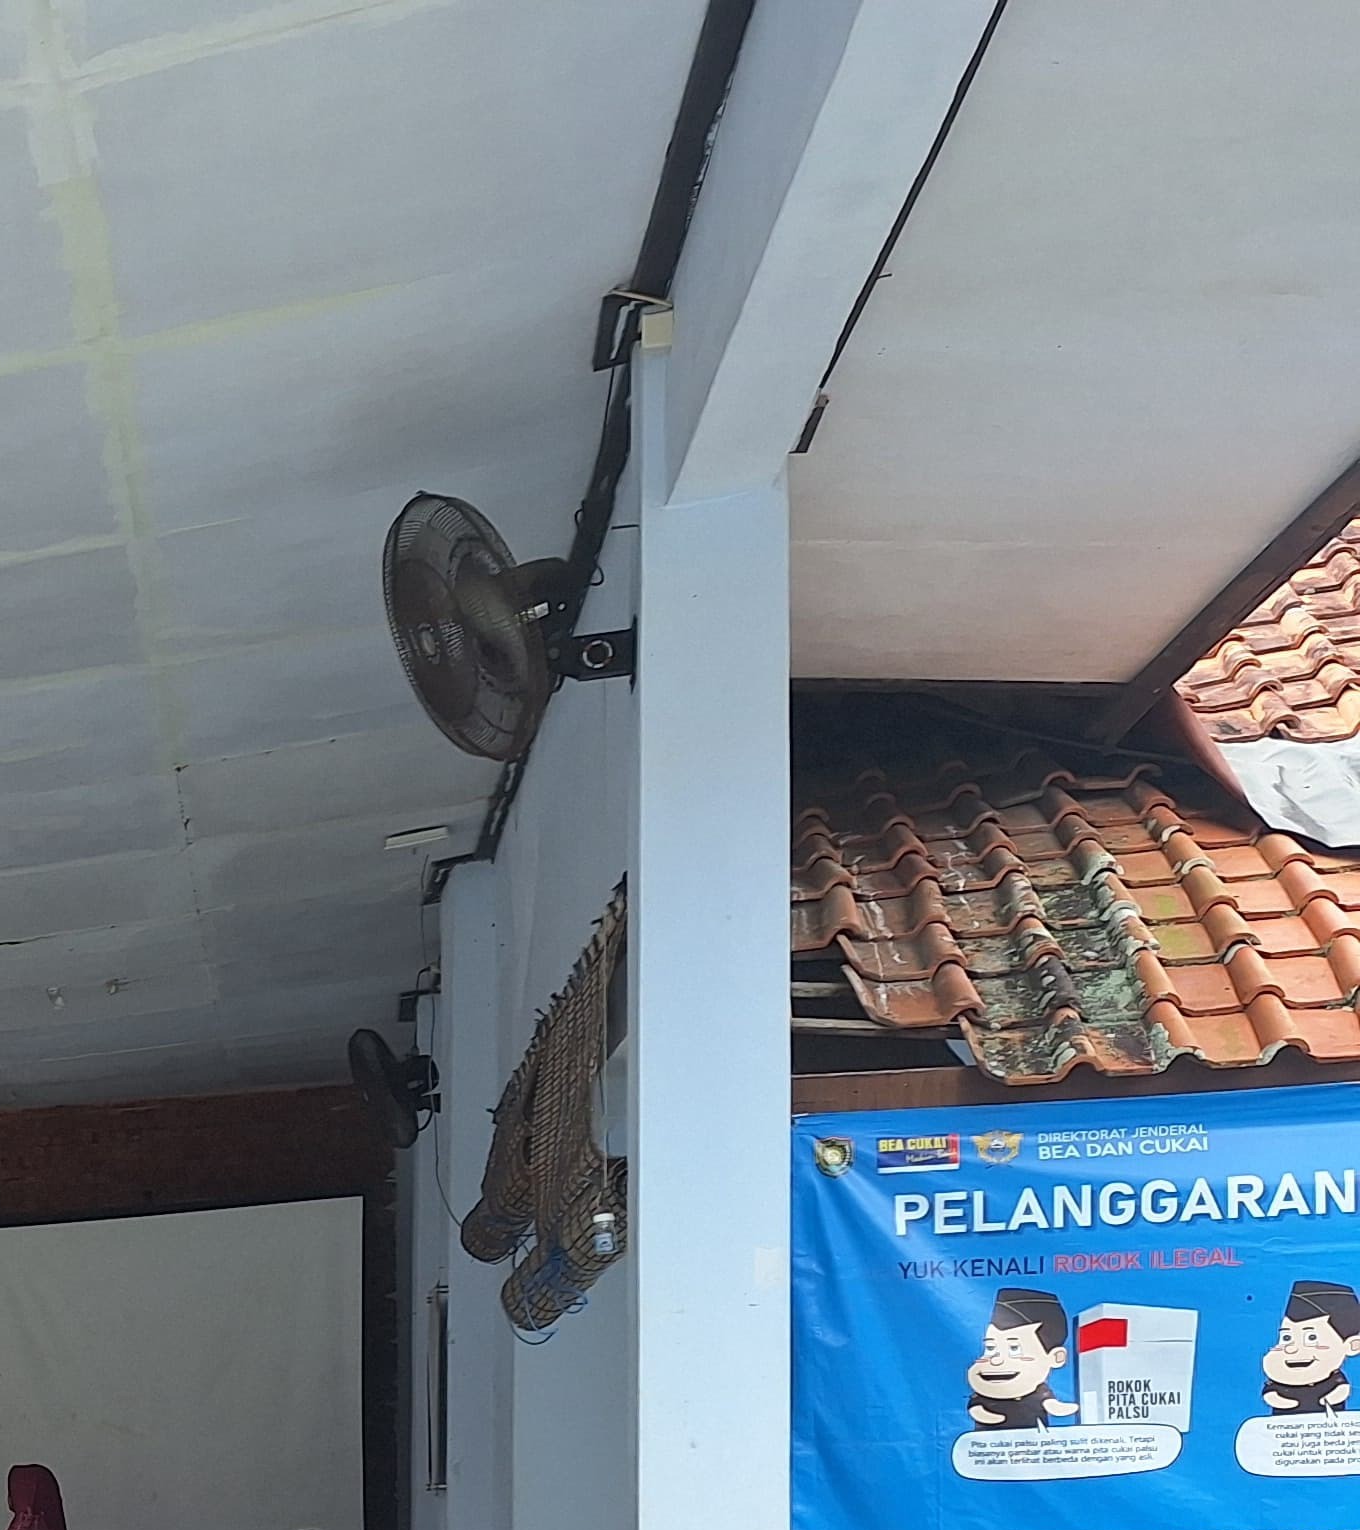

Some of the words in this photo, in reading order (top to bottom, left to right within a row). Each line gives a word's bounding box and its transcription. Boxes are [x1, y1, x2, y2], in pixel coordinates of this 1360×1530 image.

[1038, 1128, 1127, 1144] DIREKTORAT
[1131, 1124, 1208, 1138] JENDERAL
[879, 1139, 904, 1152] BEA
[906, 1137, 947, 1150] CUKAI
[1038, 1145, 1080, 1160] BEA
[1086, 1141, 1133, 1157] DAN
[1139, 1137, 1209, 1154] CUKAI
[894, 1169, 1356, 1236] PELANGGARAN
[898, 1260, 950, 1280] YUK
[953, 1255, 1045, 1277] KENALI
[1053, 1252, 1141, 1274] ROKOK
[1149, 1247, 1244, 1270] ILEGAL
[1108, 1379, 1151, 1394] ROKOK
[1108, 1393, 1136, 1406] PITA
[1141, 1391, 1181, 1405] CUKAI
[1108, 1406, 1149, 1419] PALSU
